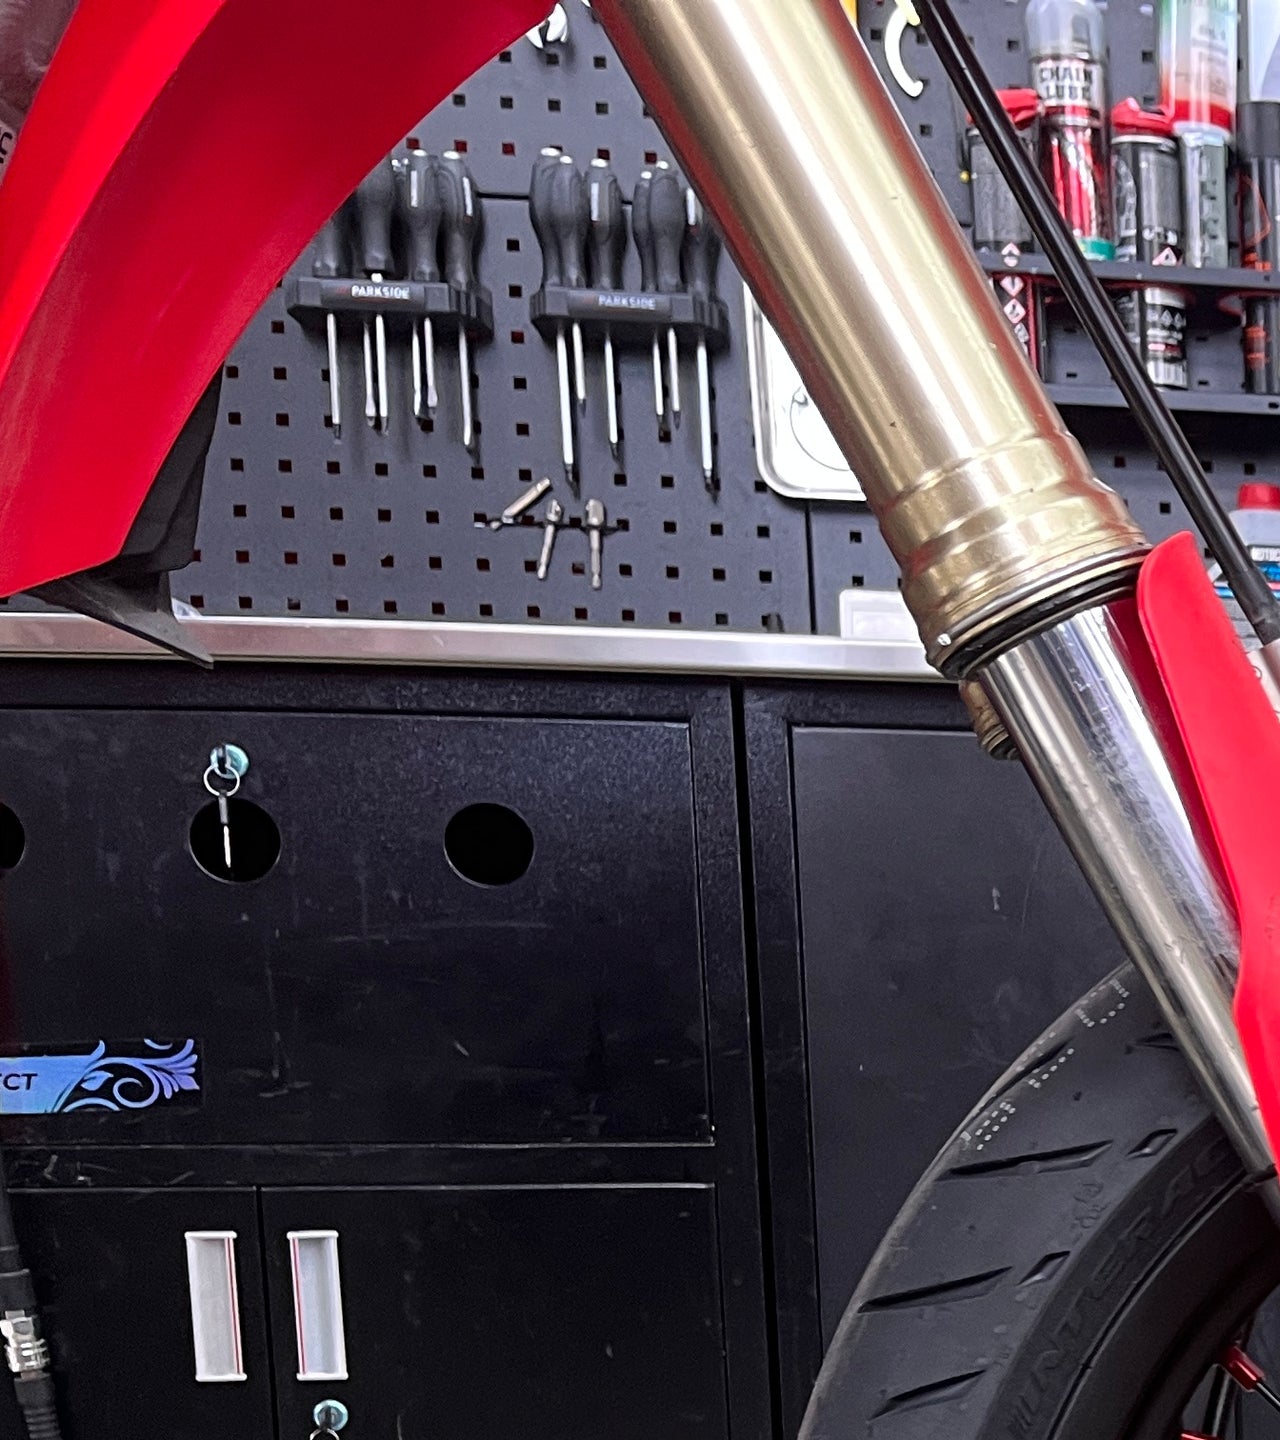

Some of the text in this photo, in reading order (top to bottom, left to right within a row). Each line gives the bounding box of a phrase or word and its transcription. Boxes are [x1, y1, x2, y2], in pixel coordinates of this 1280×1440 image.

[350, 285, 411, 300] PARKSIDE
[598, 294, 657, 310] PARKSIDE
[0, 1072, 39, 1091] CT
